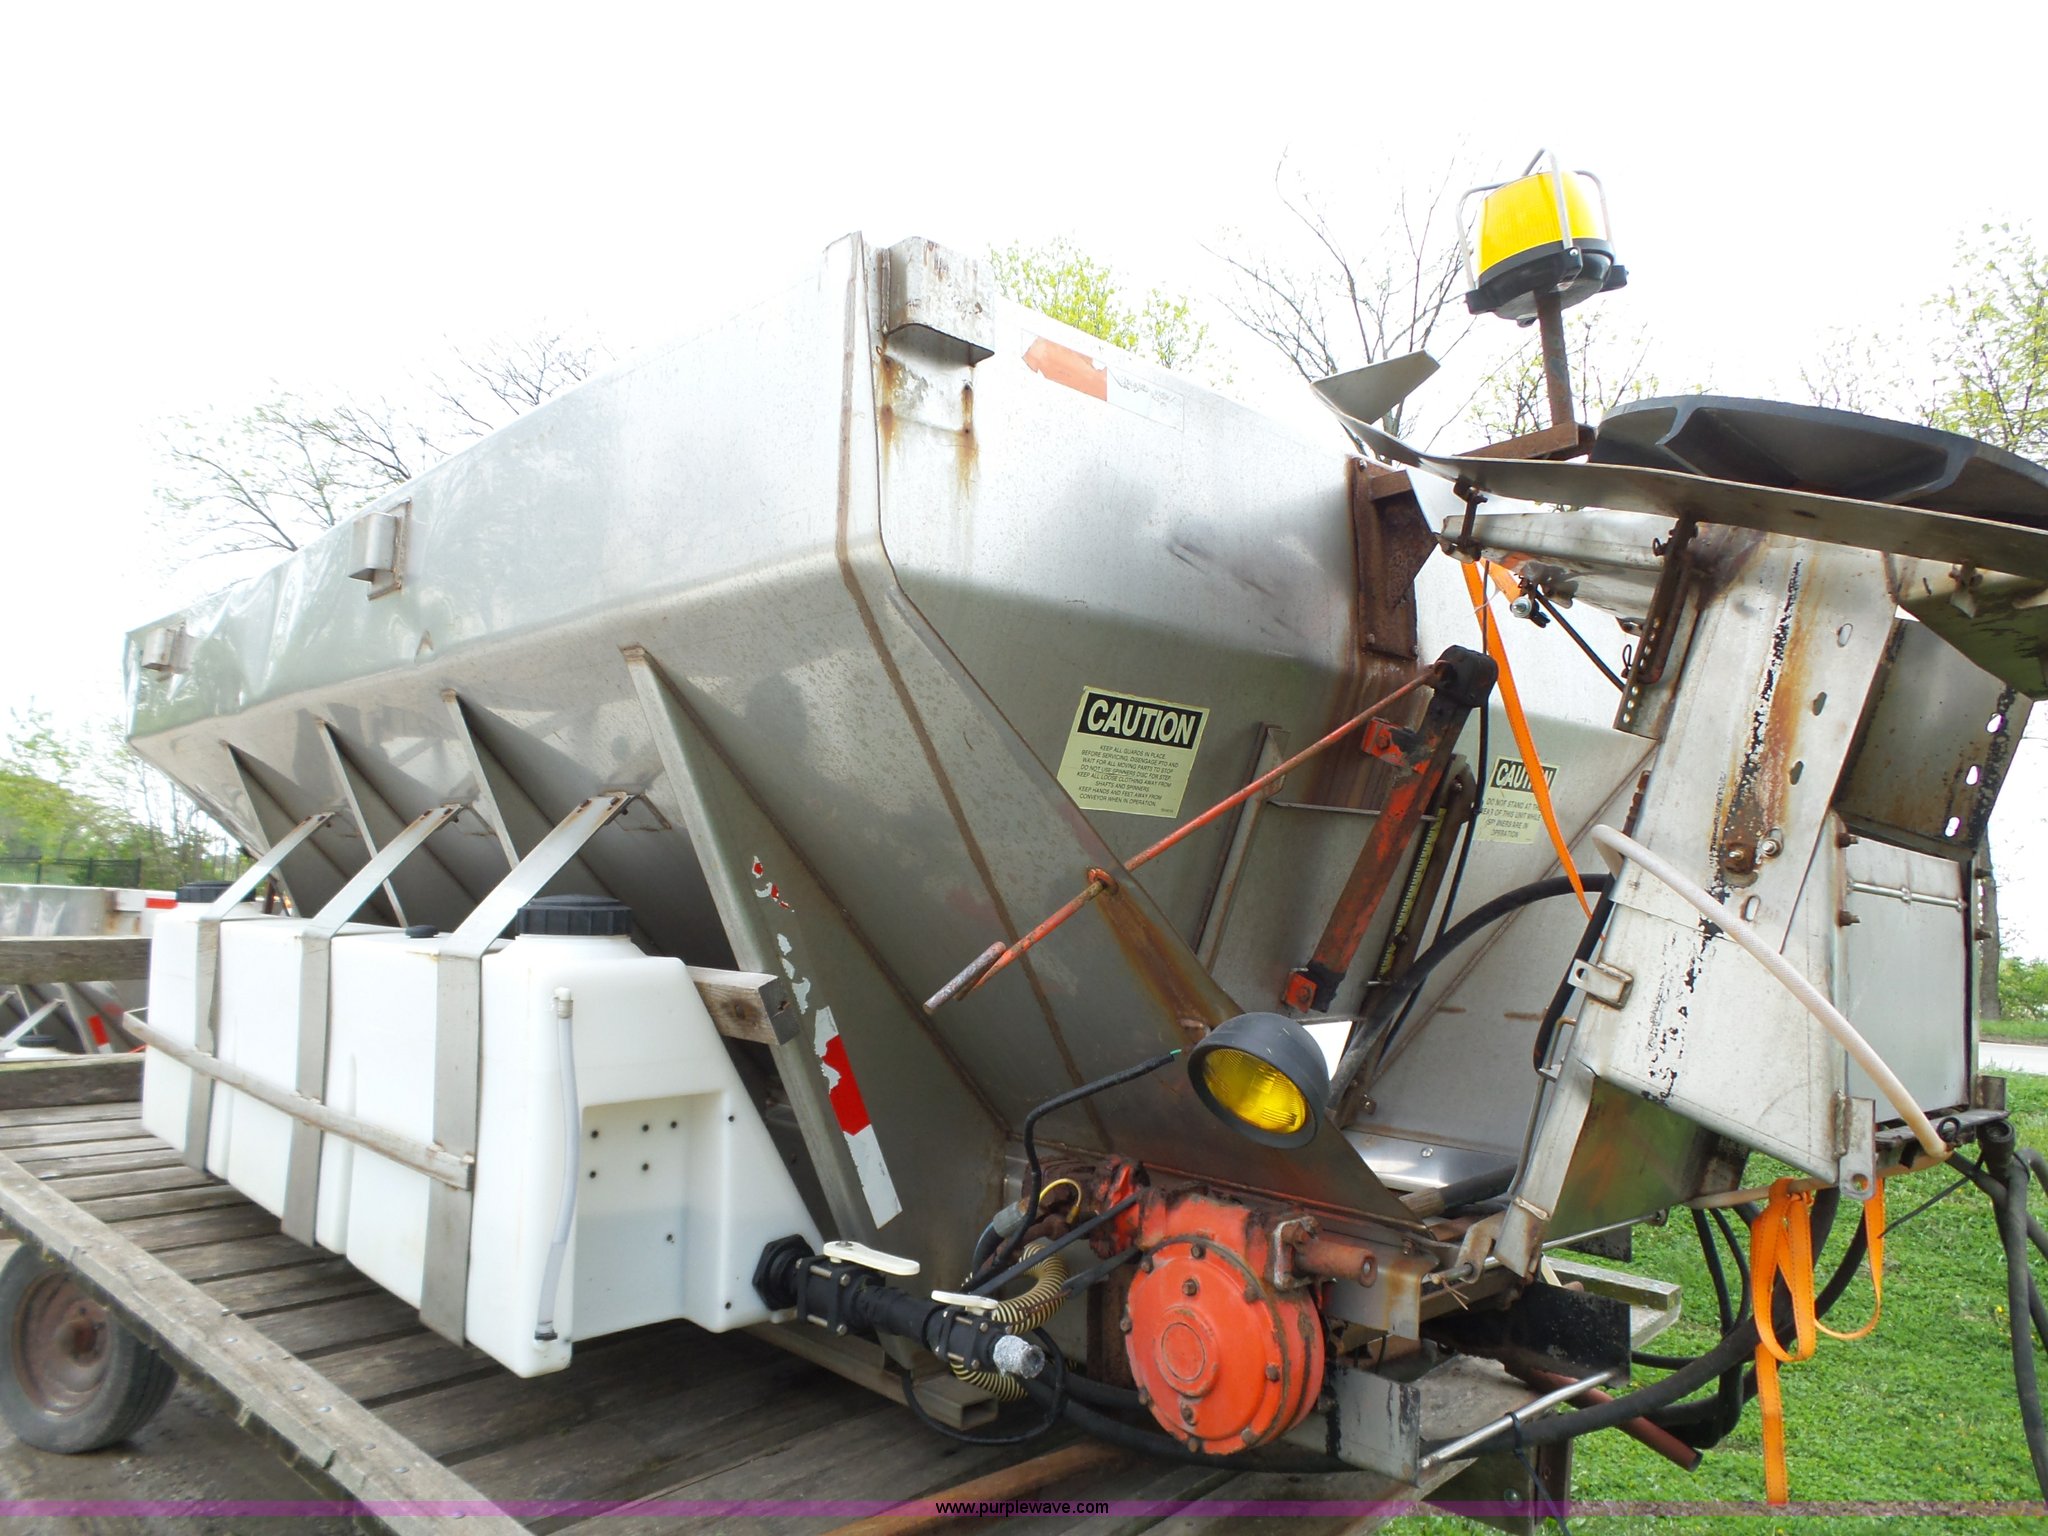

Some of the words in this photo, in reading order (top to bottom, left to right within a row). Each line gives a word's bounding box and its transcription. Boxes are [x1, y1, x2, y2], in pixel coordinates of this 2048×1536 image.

[1087, 699, 1196, 745] CAUTION
[1124, 747, 1144, 756] GUARDS
[1081, 749, 1101, 757] BEFORE
[1130, 755, 1157, 765] DISENGAGE
[1117, 761, 1137, 769] MOVING
[1137, 764, 1153, 772] PARTS
[1112, 768, 1136, 777] SPINNERS
[1095, 780, 1114, 788] SHAFTS
[1118, 776, 1143, 784] CLOTHING
[1079, 793, 1107, 801] CONVEYOR
